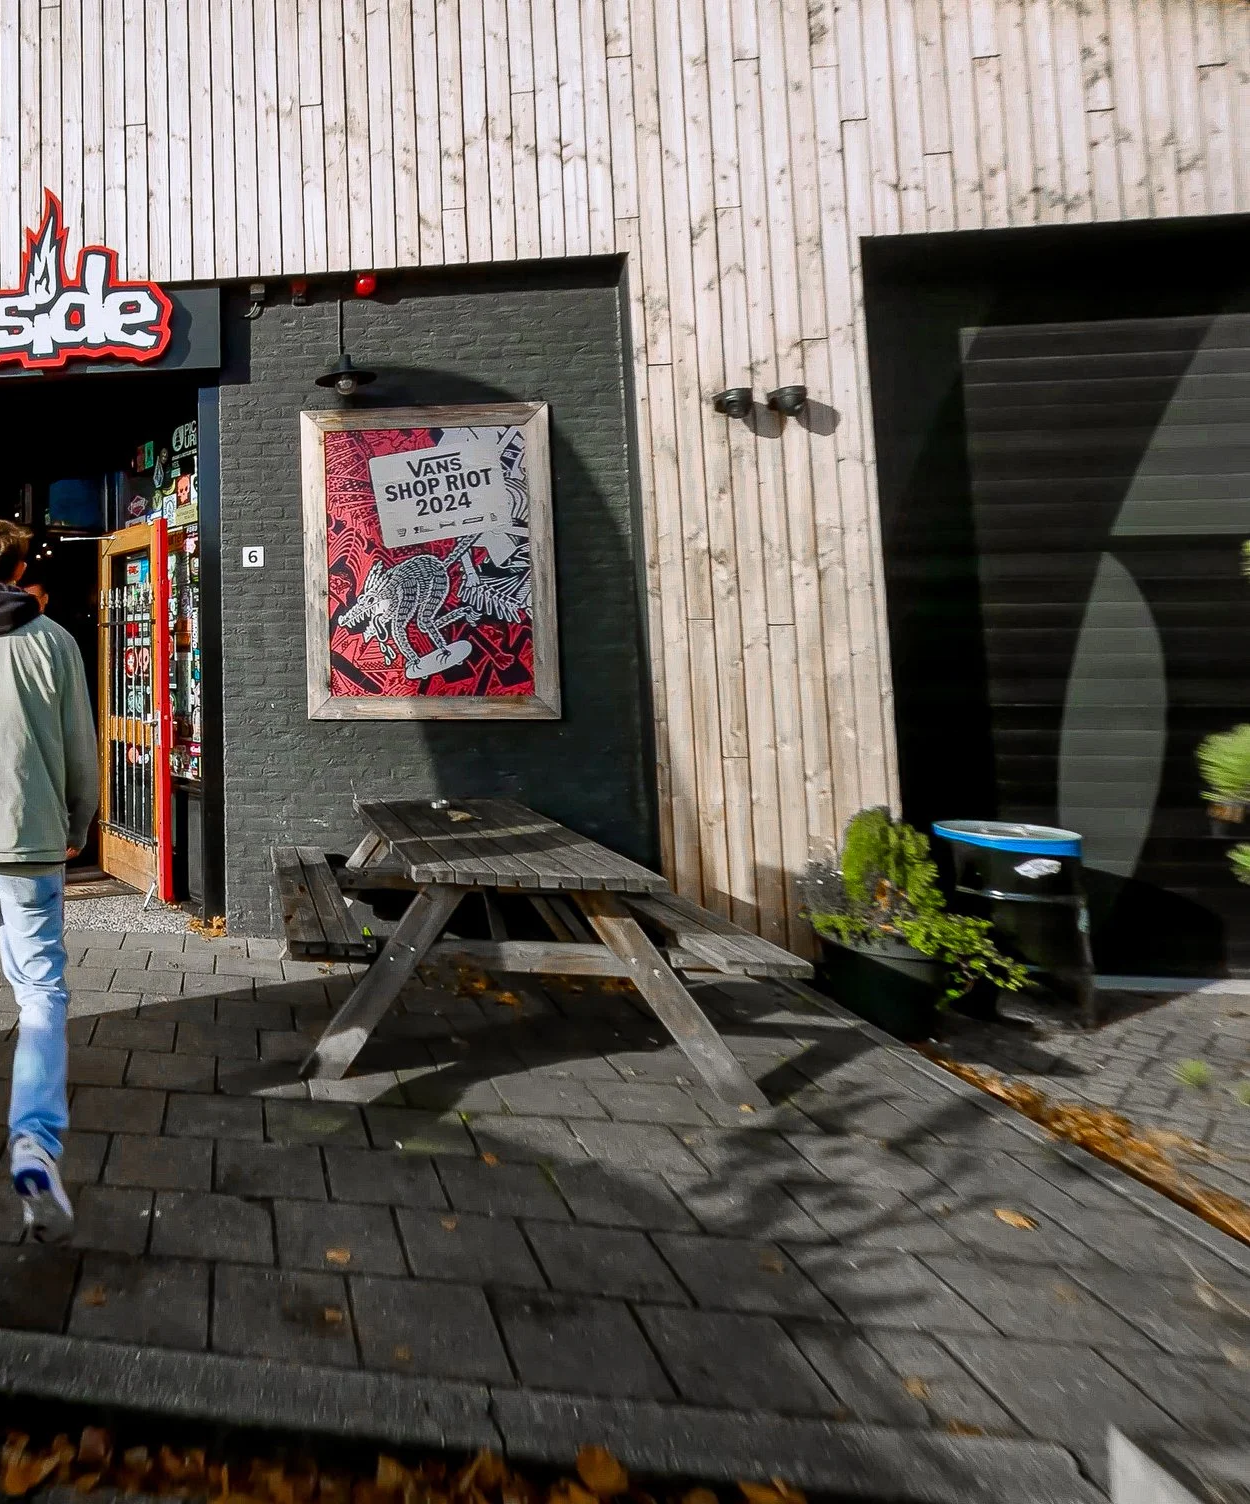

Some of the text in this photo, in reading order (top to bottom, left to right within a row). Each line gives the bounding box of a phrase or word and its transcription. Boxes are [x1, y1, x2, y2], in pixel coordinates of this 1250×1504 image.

[406, 452, 462, 478] VANS
[384, 467, 492, 502] SHOP RIOT
[415, 491, 472, 517] 2024
[248, 550, 258, 563] 6
